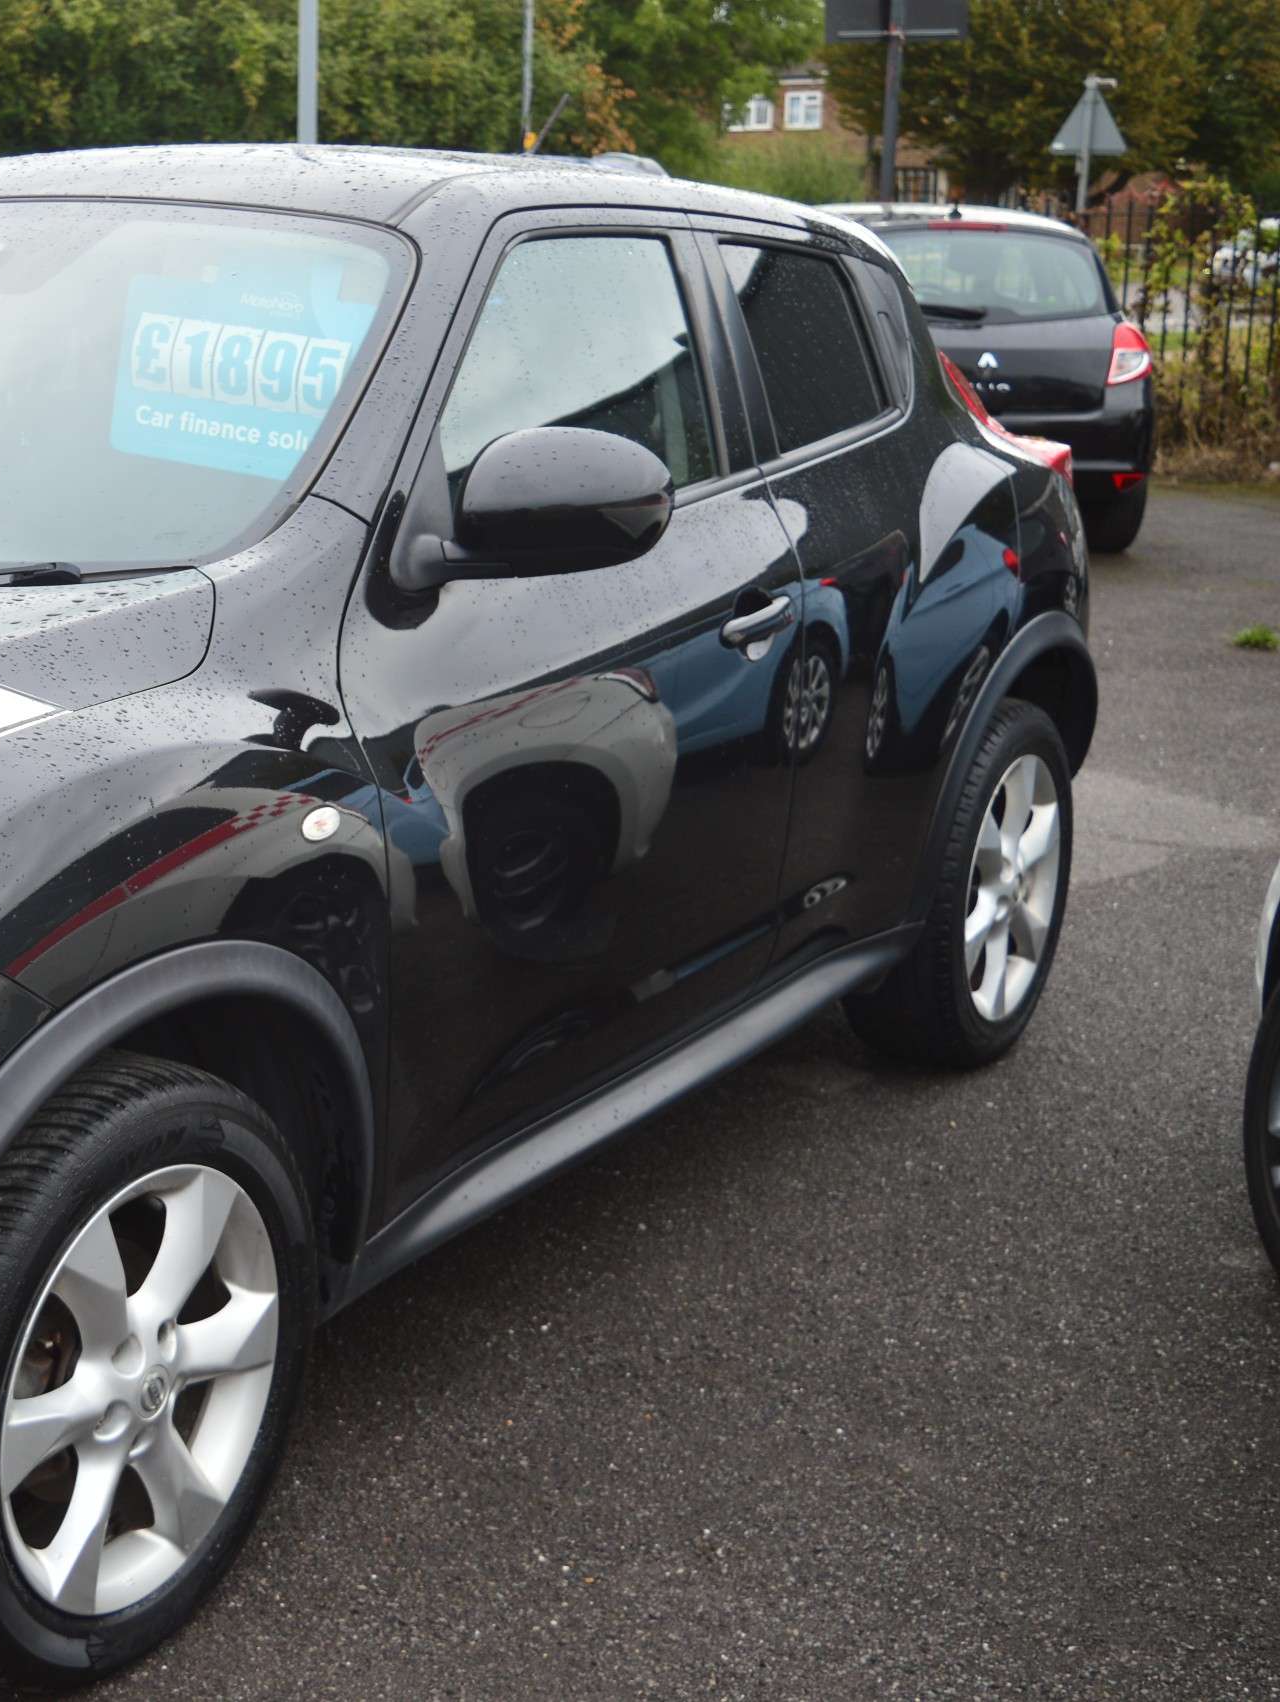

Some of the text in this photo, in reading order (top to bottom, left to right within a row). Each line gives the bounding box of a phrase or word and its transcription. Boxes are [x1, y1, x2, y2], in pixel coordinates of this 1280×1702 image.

[135, 320, 341, 411] £1895
[135, 405, 173, 429] Car
[179, 411, 261, 444] finance
